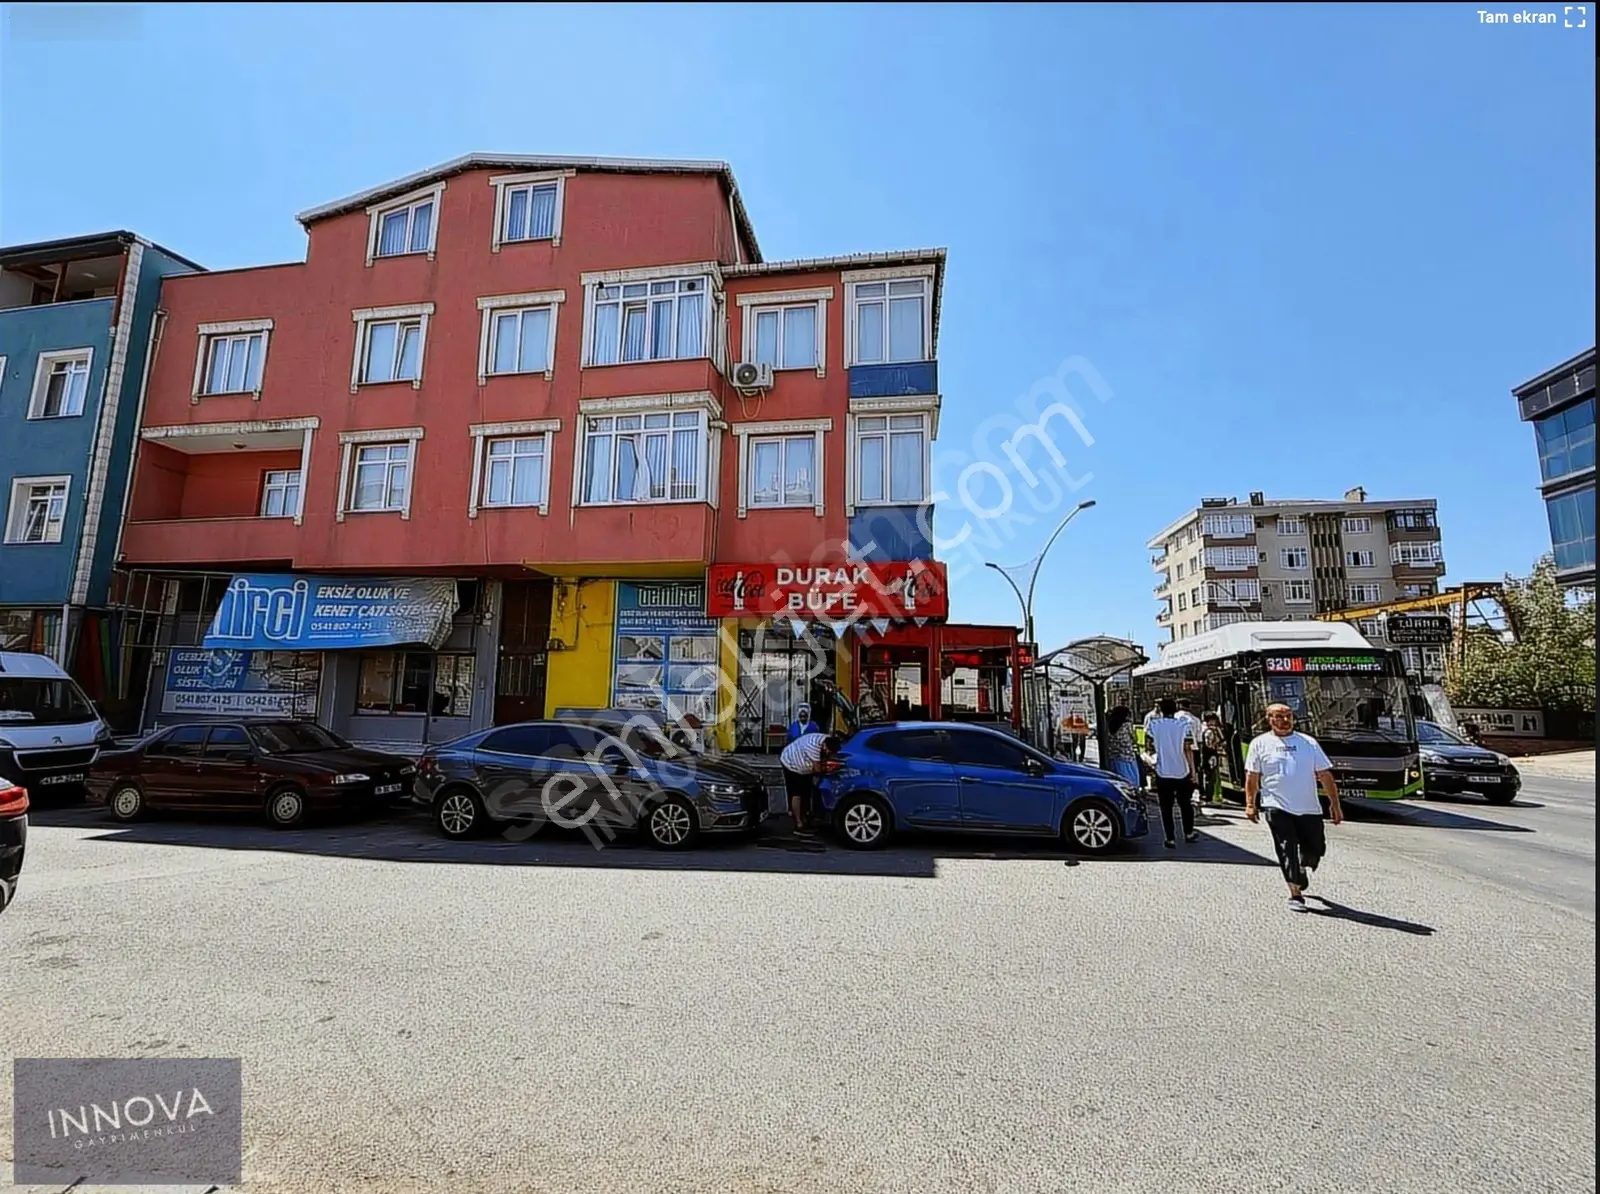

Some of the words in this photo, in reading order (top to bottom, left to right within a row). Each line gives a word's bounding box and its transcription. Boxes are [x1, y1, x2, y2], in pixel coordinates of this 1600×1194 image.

[776, 567, 869, 585] DURAK
[316, 584, 356, 599] EKSİZ
[356, 587, 392, 599] OLUK
[394, 587, 412, 599] VE
[788, 587, 858, 610] BÜFE
[313, 604, 359, 617] KENET
[358, 604, 388, 619] ÇATI
[311, 622, 332, 631] 0541
